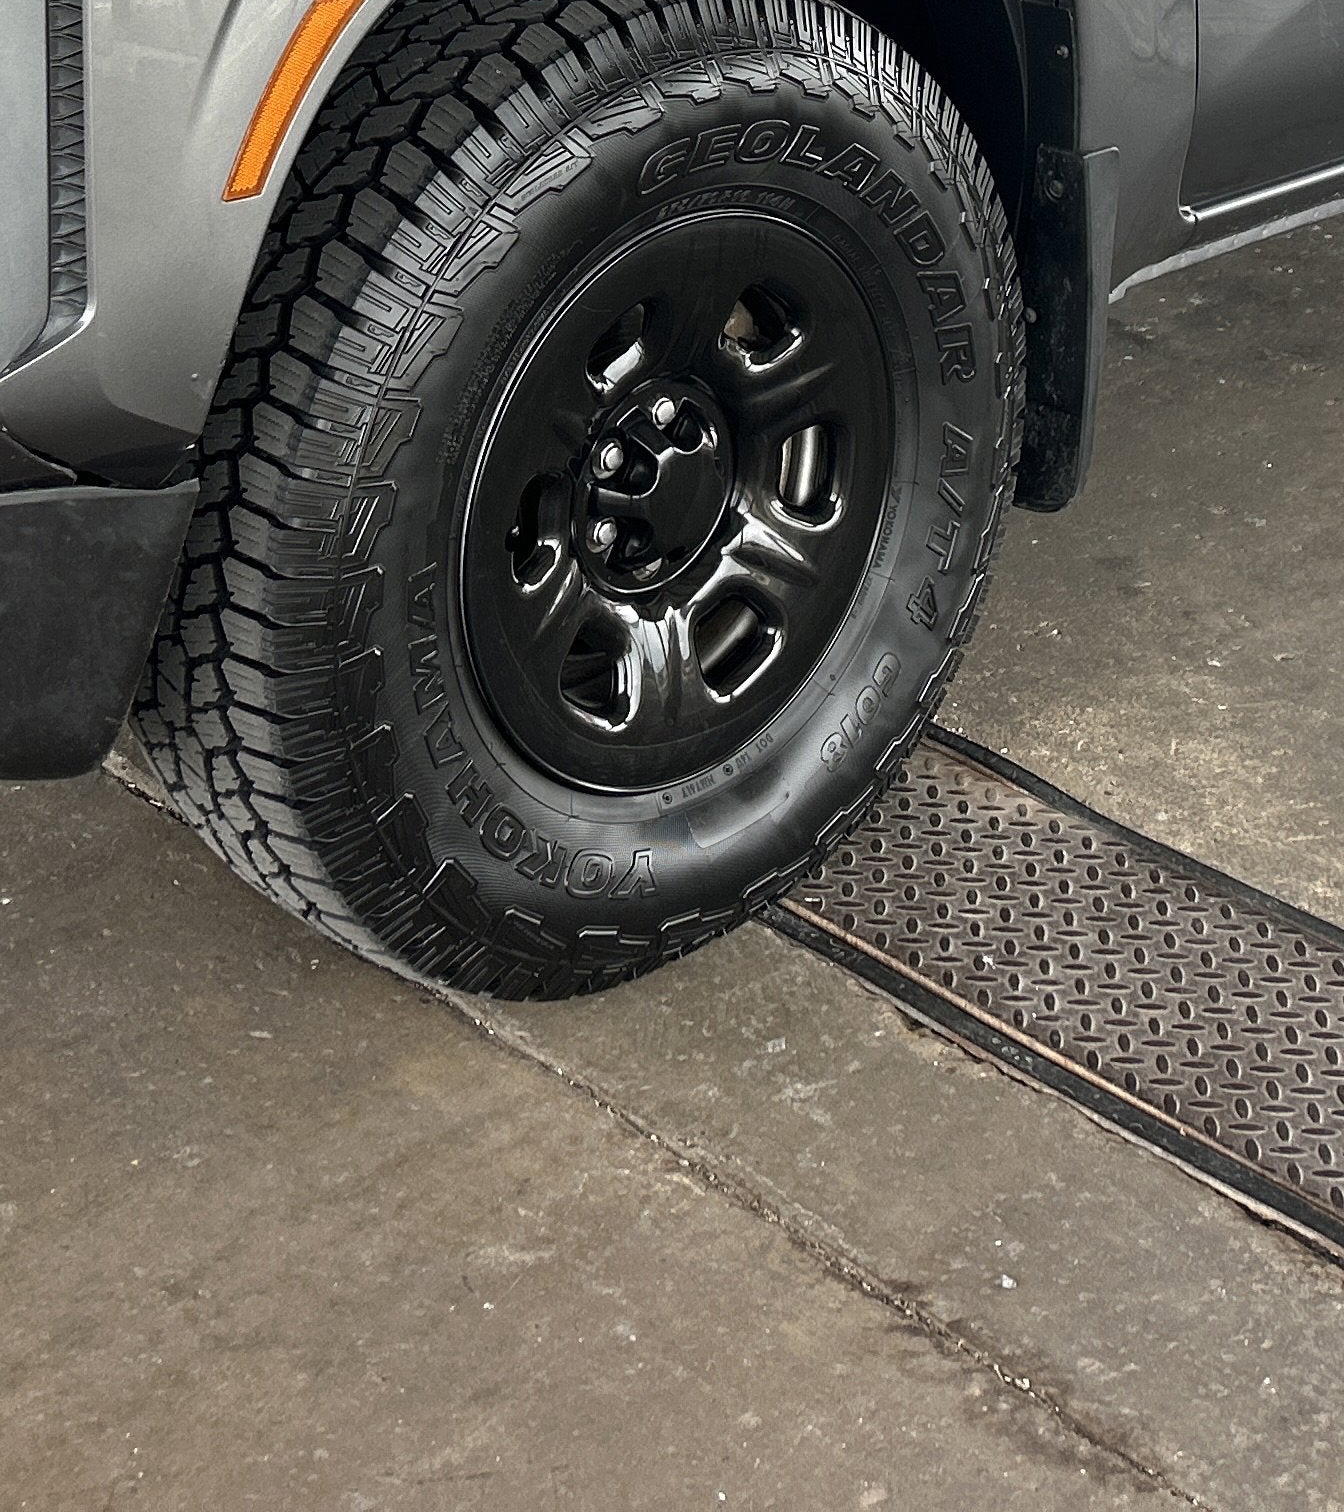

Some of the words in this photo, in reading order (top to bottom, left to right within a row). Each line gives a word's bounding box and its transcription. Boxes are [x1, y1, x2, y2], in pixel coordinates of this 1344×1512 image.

[637, 119, 977, 386] GEOLANDAR
[872, 501, 898, 569] YOKOHAMA
[407, 561, 656, 899] YOKOHAMA
